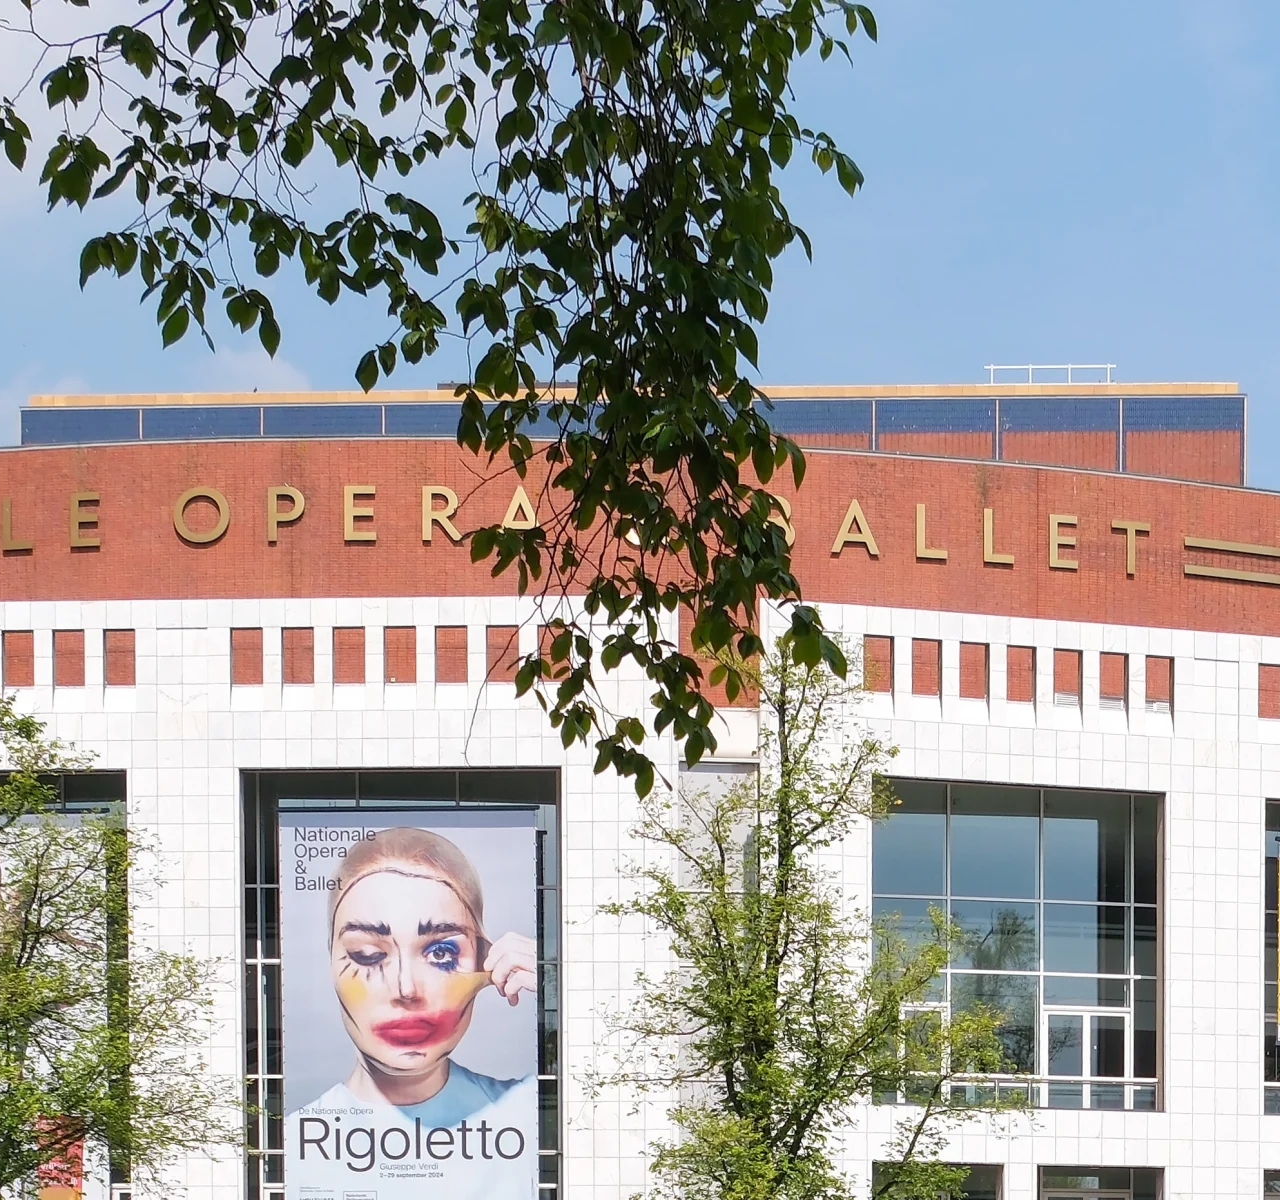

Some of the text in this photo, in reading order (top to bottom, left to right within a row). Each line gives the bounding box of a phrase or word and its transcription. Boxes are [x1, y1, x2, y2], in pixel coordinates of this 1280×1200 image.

[173, 484, 540, 546] OPERA
[294, 826, 377, 842] Nationale
[294, 843, 347, 862] Opera
[294, 859, 308, 875] &
[294, 875, 344, 891] Ballet
[299, 1107, 374, 1117] De Nationale Opera
[299, 1116, 525, 1173] Rigoletto
[380, 1163, 416, 1171] Giuseppe
